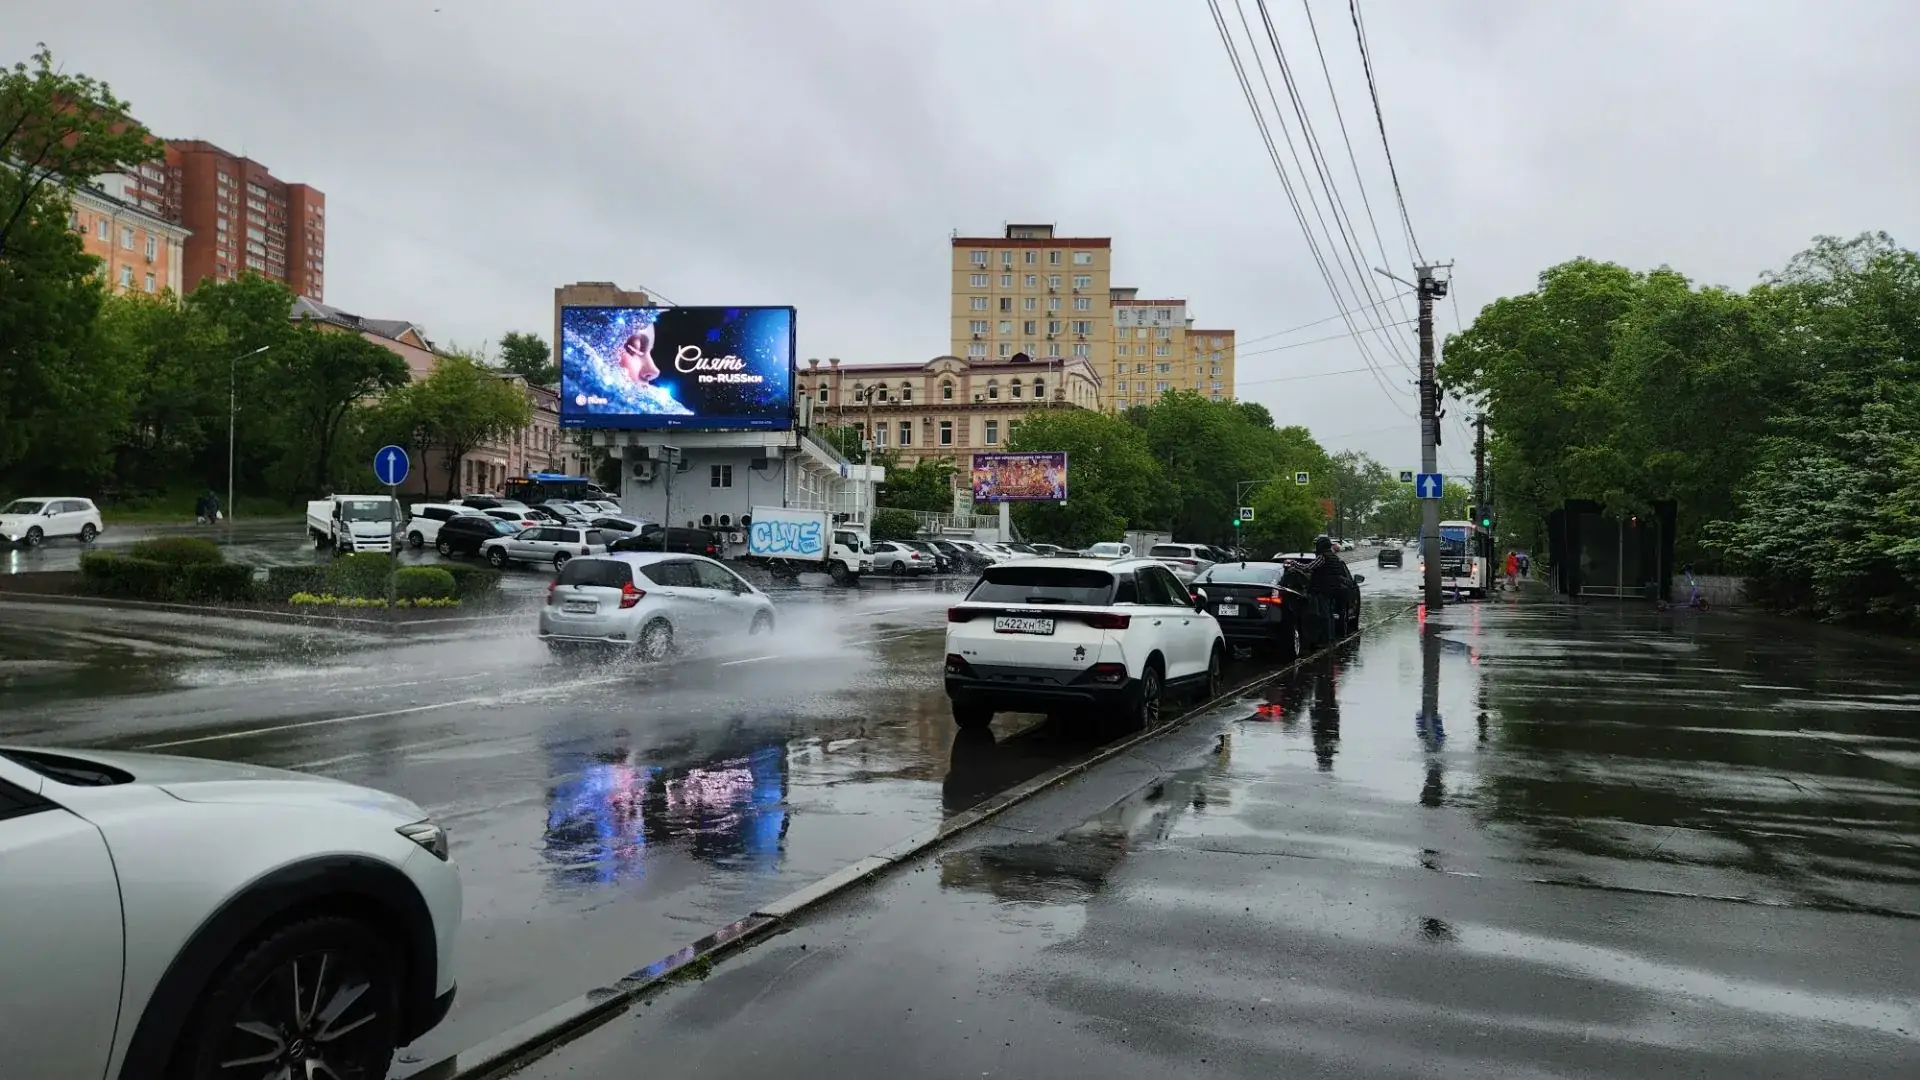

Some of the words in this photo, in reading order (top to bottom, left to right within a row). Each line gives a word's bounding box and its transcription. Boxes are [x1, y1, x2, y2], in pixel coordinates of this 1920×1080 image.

[675, 345, 746, 373] Сиять
[698, 373, 763, 383] по-RUSSки
[751, 521, 822, 554] CLMS
